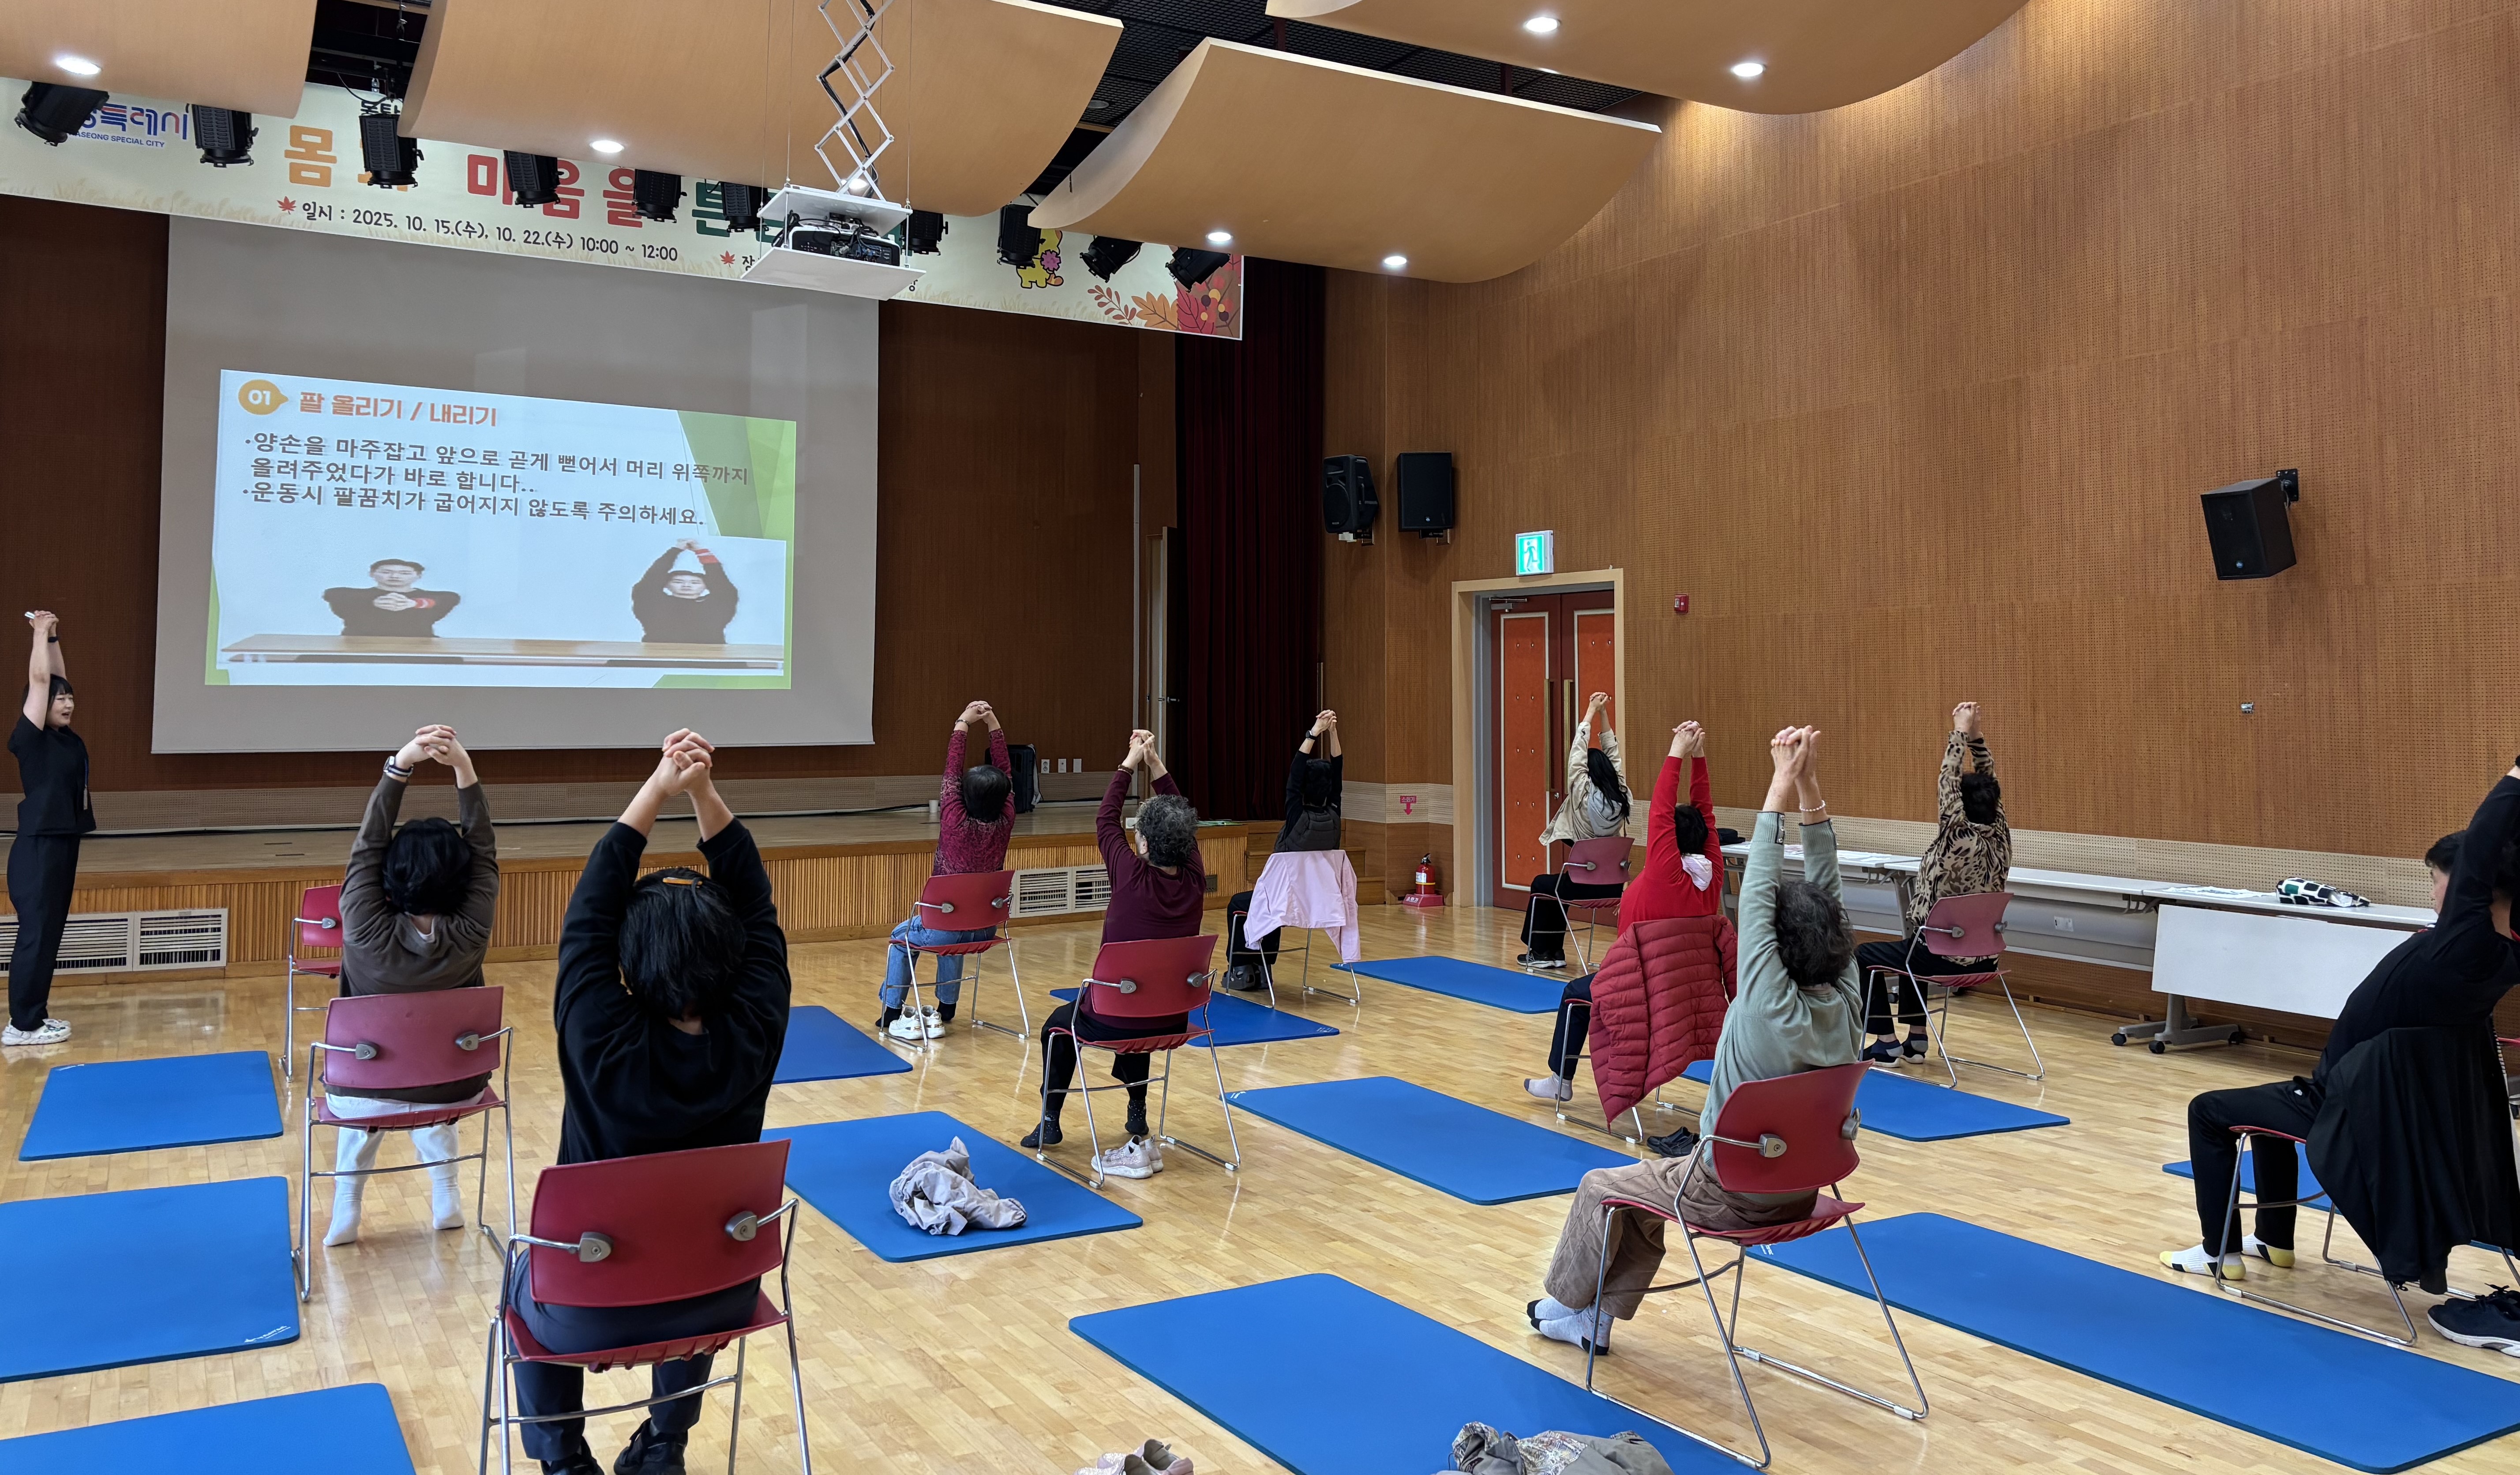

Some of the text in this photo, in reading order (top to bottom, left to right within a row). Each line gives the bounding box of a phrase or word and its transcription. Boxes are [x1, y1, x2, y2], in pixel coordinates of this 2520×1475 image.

[82, 103, 188, 140] 특례시
[111, 135, 144, 145] SPECIAL
[302, 201, 332, 221] 일시
[352, 209, 398, 228] 2025.
[406, 215, 427, 232] 10.
[496, 227, 516, 242] 10.
[523, 230, 573, 249] 22.(수)
[580, 237, 619, 255] 10:00
[641, 244, 678, 261] 12:00
[248, 389, 271, 405] 01
[300, 391, 497, 427] 팔 올리기 / 내리기
[251, 458, 395, 485] 올려주었다가
[405, 468, 447, 487] 바로
[336, 439, 427, 461] 마주잡고
[436, 446, 499, 466] 앞으로
[509, 451, 548, 471] 곧게
[558, 455, 617, 476] 뻗어서
[626, 460, 663, 479] 머리
[672, 464, 748, 485] 위쪽까지
[334, 487, 426, 510] 팔꿈치가
[434, 493, 518, 516] 굽어지지
[529, 499, 590, 520] 않도록
[598, 503, 704, 525] 주의하세요.
